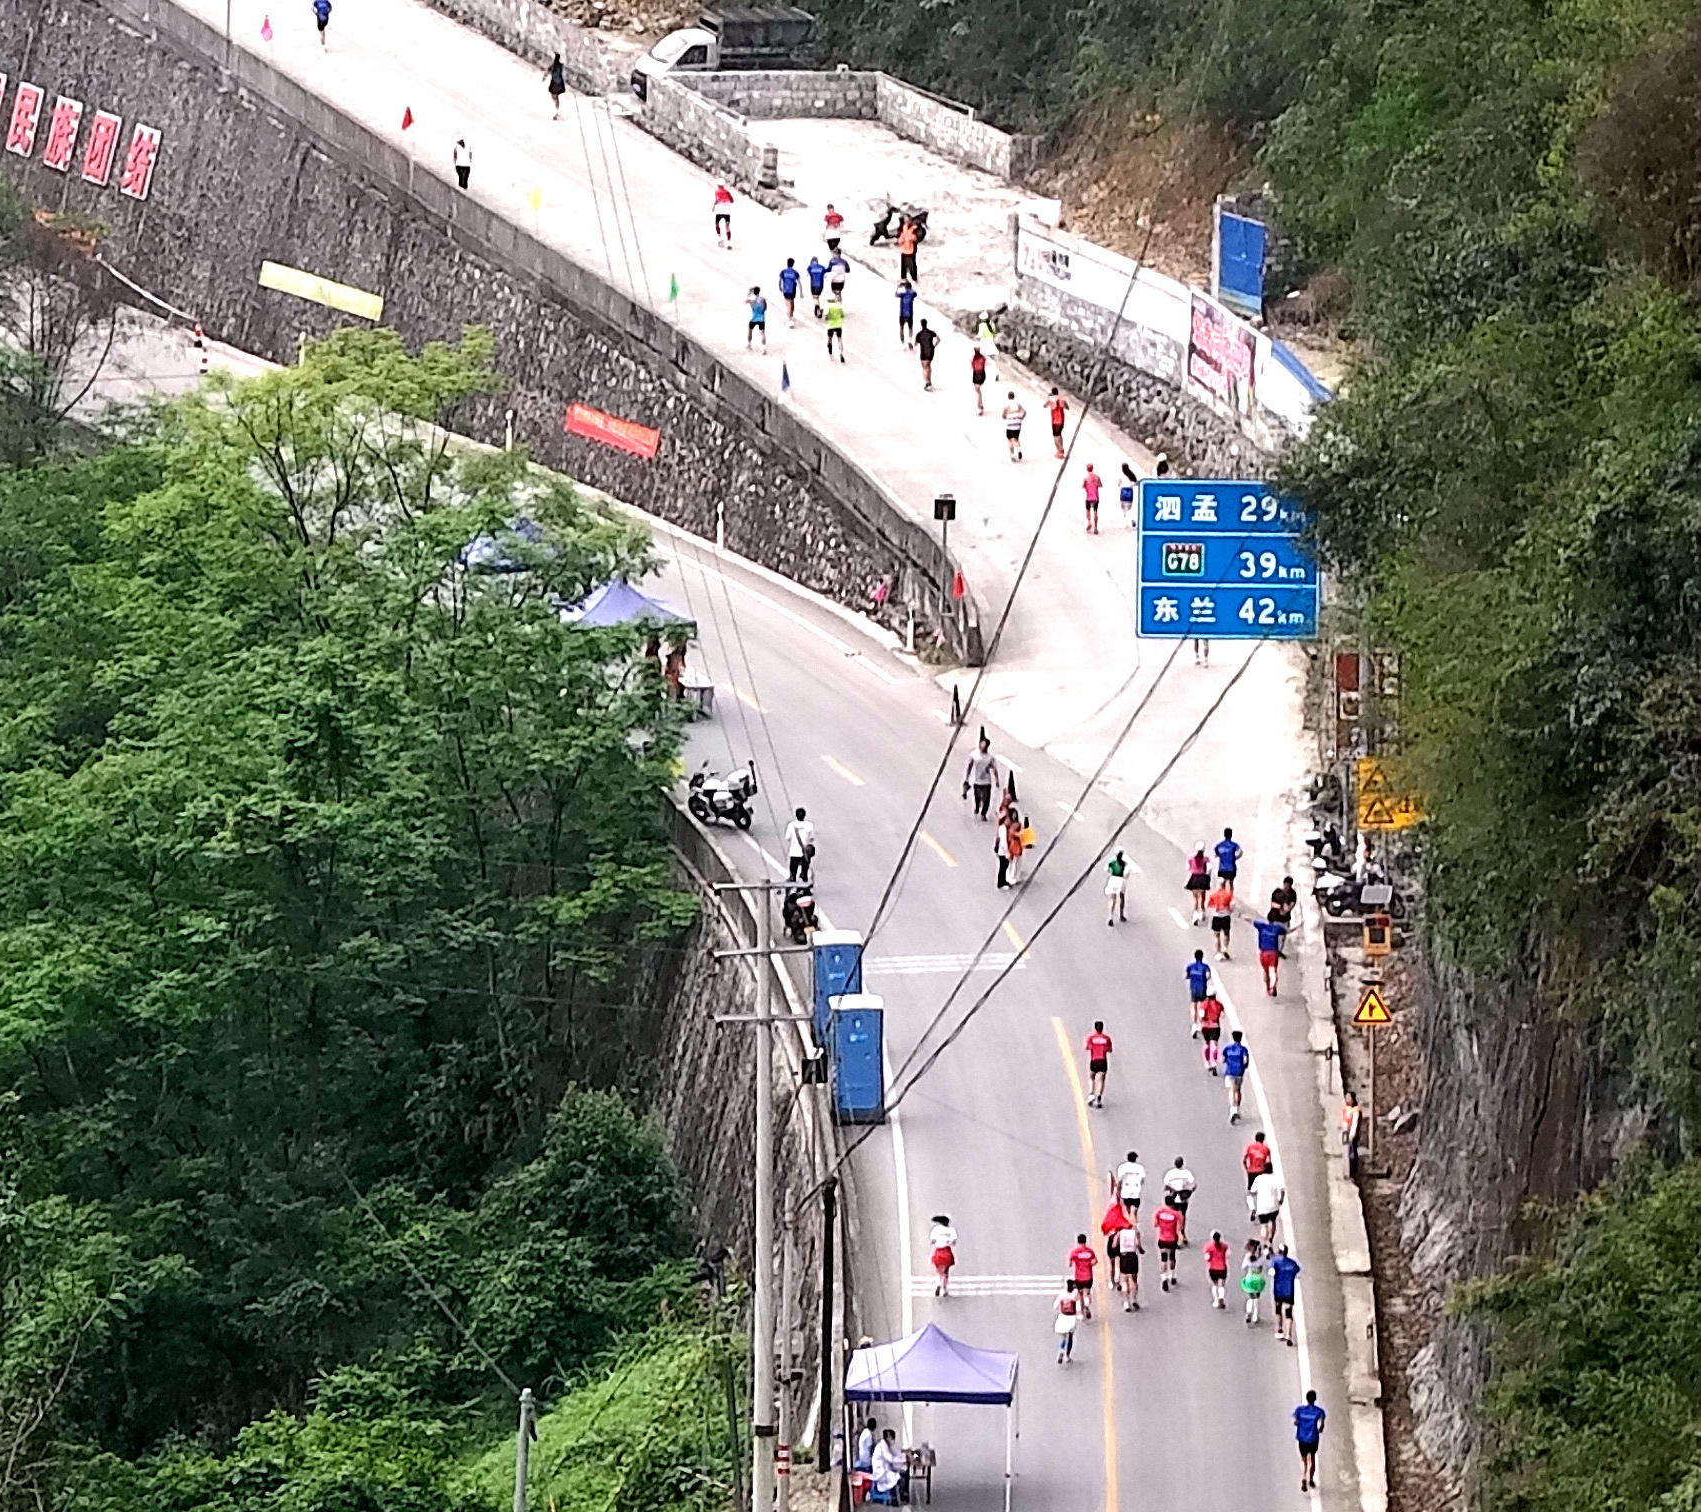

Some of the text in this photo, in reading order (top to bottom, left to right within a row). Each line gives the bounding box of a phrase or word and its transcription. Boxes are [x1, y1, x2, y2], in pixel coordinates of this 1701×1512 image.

[1154, 494, 1219, 522] 泗孟
[1167, 552, 1200, 571] G78
[1153, 596, 1217, 623] 东兰
